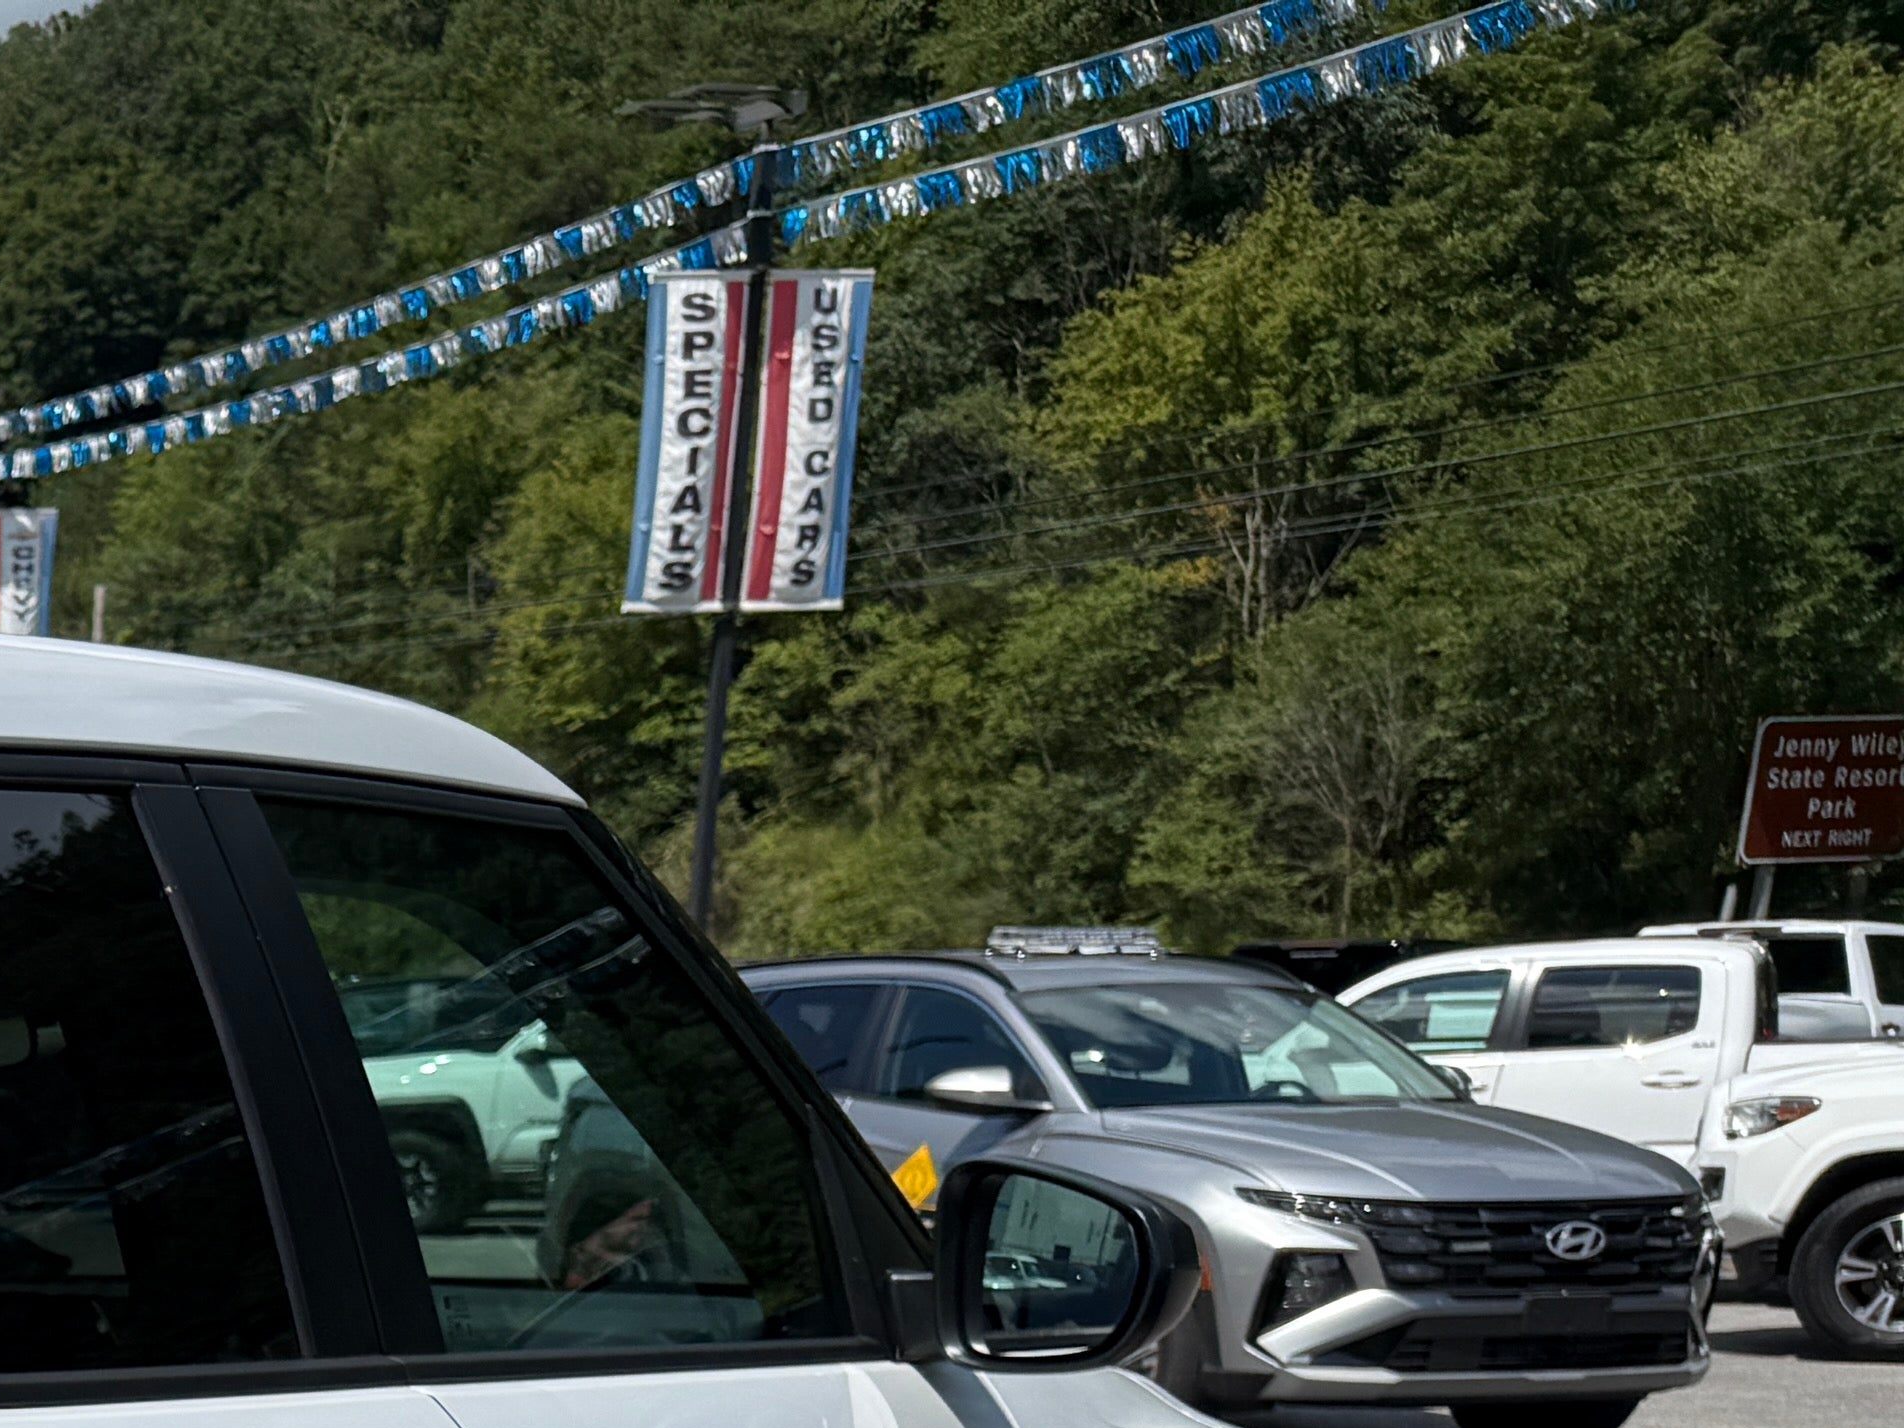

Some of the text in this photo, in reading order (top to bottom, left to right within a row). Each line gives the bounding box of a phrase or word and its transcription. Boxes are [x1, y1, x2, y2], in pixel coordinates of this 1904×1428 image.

[657, 291, 716, 591] SPECIALS
[789, 287, 838, 586] USED CARS
[1773, 734, 1841, 763] Jenny
[1766, 764, 1904, 791] State Resort
[1807, 794, 1857, 820] Park
[1780, 826, 1873, 849] NEXT RIGHT
